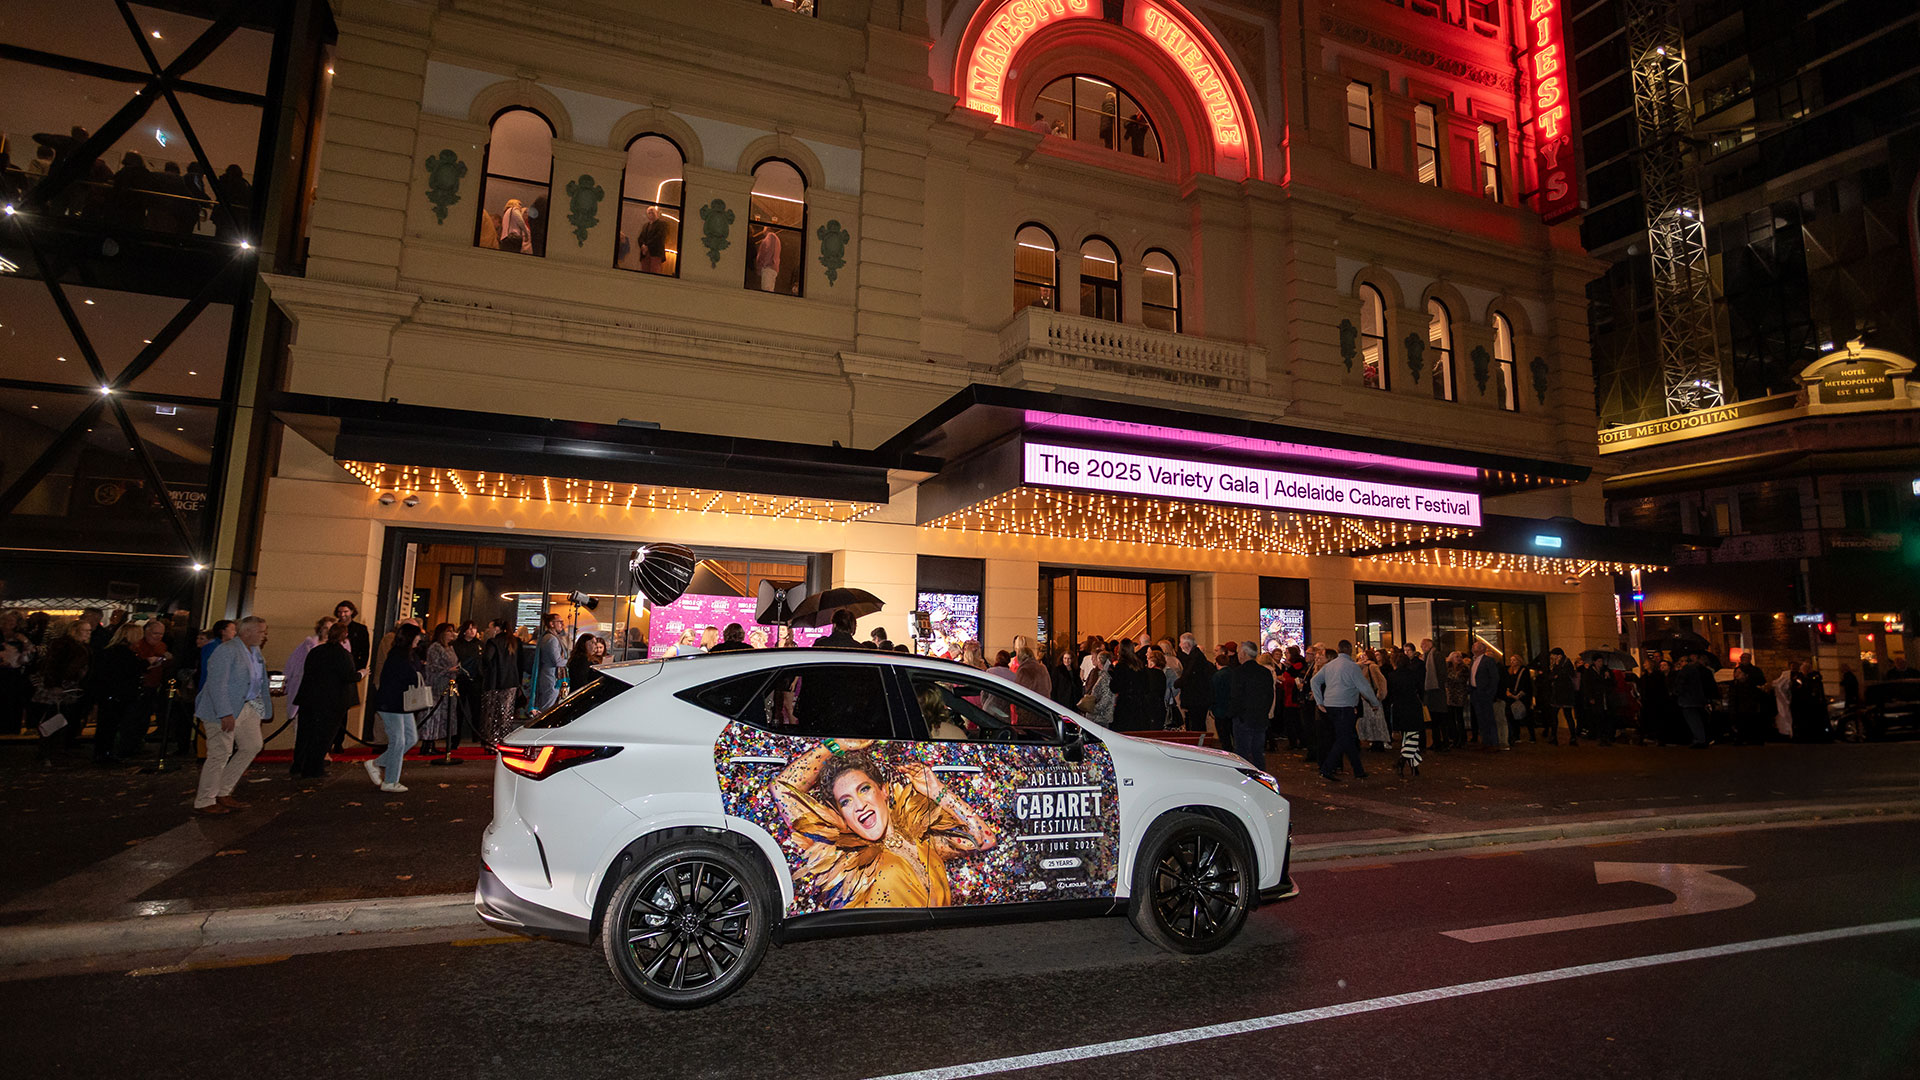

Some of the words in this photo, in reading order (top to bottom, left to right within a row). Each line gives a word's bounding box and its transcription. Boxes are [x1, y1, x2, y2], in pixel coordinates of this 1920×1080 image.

[1145, 8, 1241, 145] THEATRE
[1841, 369, 1866, 377] HOTEL
[1825, 377, 1885, 387] METROPOLITAN
[1636, 408, 1739, 437] METROPOLITAN
[1040, 453, 1080, 475] The
[1087, 459, 1142, 481] 2025
[1148, 465, 1214, 493] Variety
[1219, 473, 1259, 494] Gala
[1274, 479, 1345, 502] Adelaide
[1349, 488, 1411, 510] Cabaret
[1415, 495, 1471, 516] Festival
[1031, 772, 1087, 786] ADELAIDE
[1017, 792, 1102, 819] CABARET
[1034, 819, 1086, 833] FESTIVAL
[1049, 841, 1069, 852] JUNE
[1075, 840, 1095, 850] 2025
